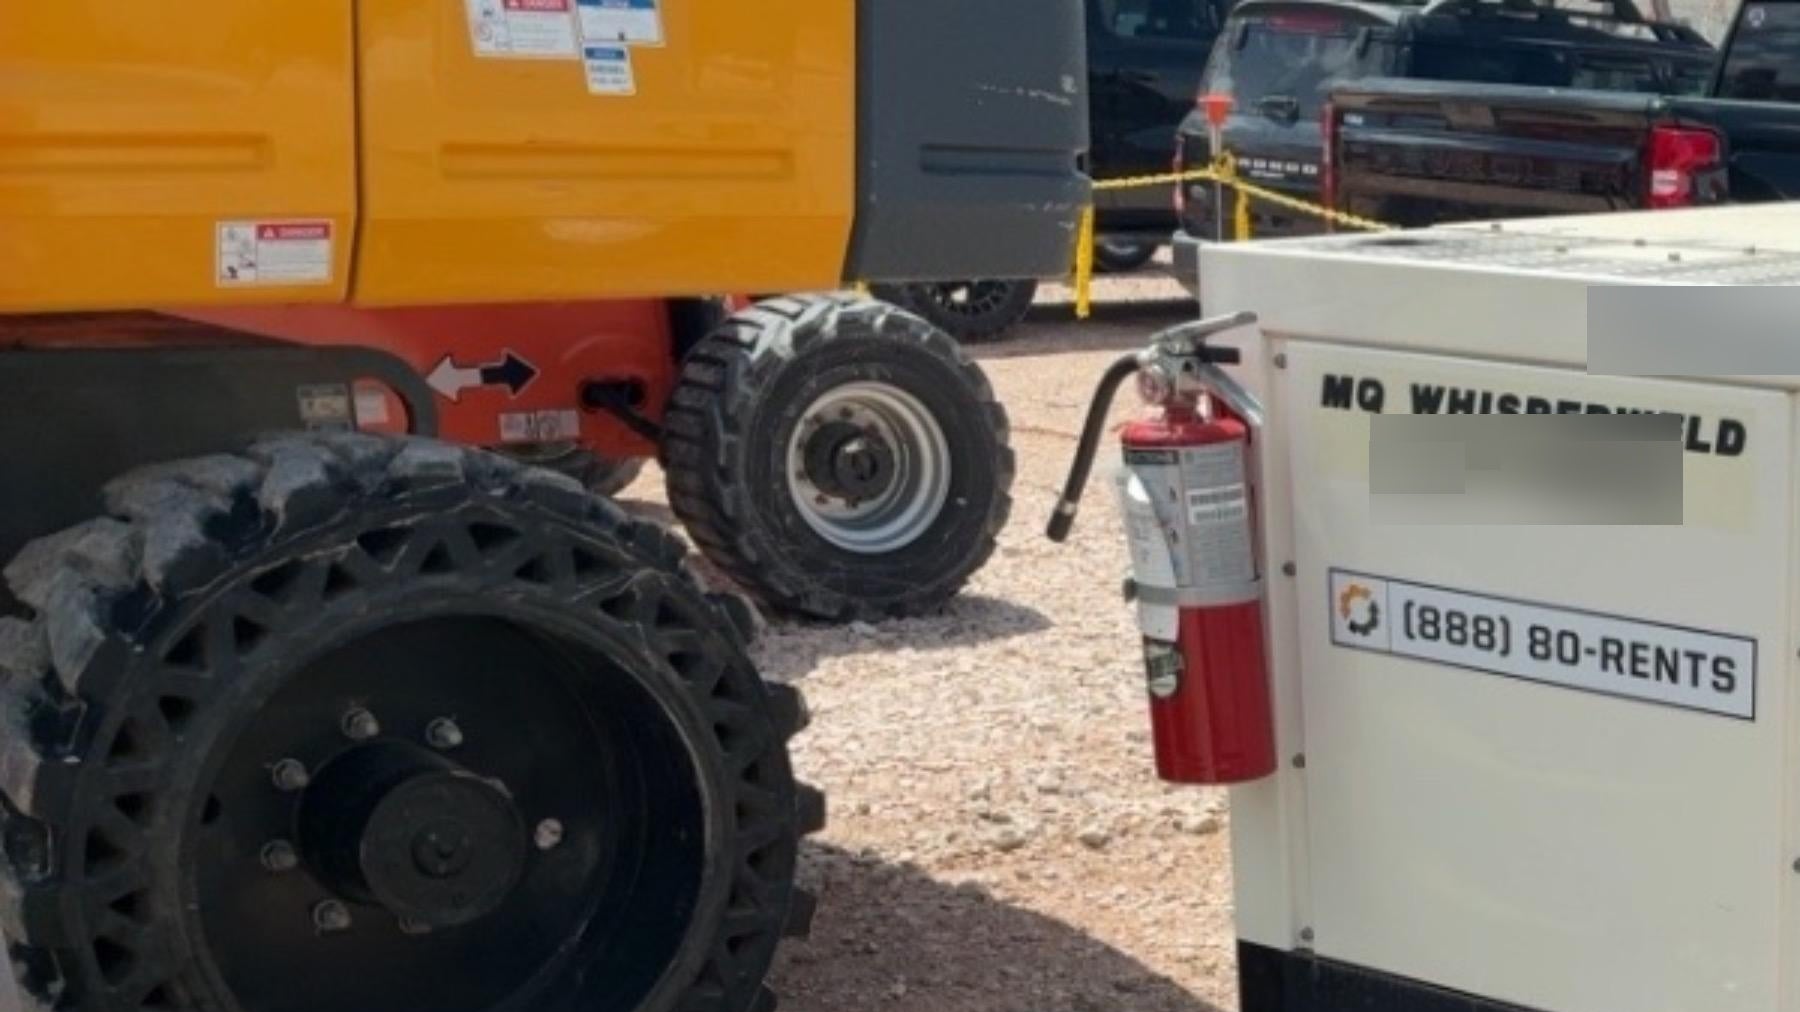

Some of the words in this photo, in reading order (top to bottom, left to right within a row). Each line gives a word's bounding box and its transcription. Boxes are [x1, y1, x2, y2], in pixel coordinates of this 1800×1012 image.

[1320, 374, 1386, 414] MQ
[1403, 599, 1512, 657] (888)
[1528, 625, 1737, 694] 80-RENTS
